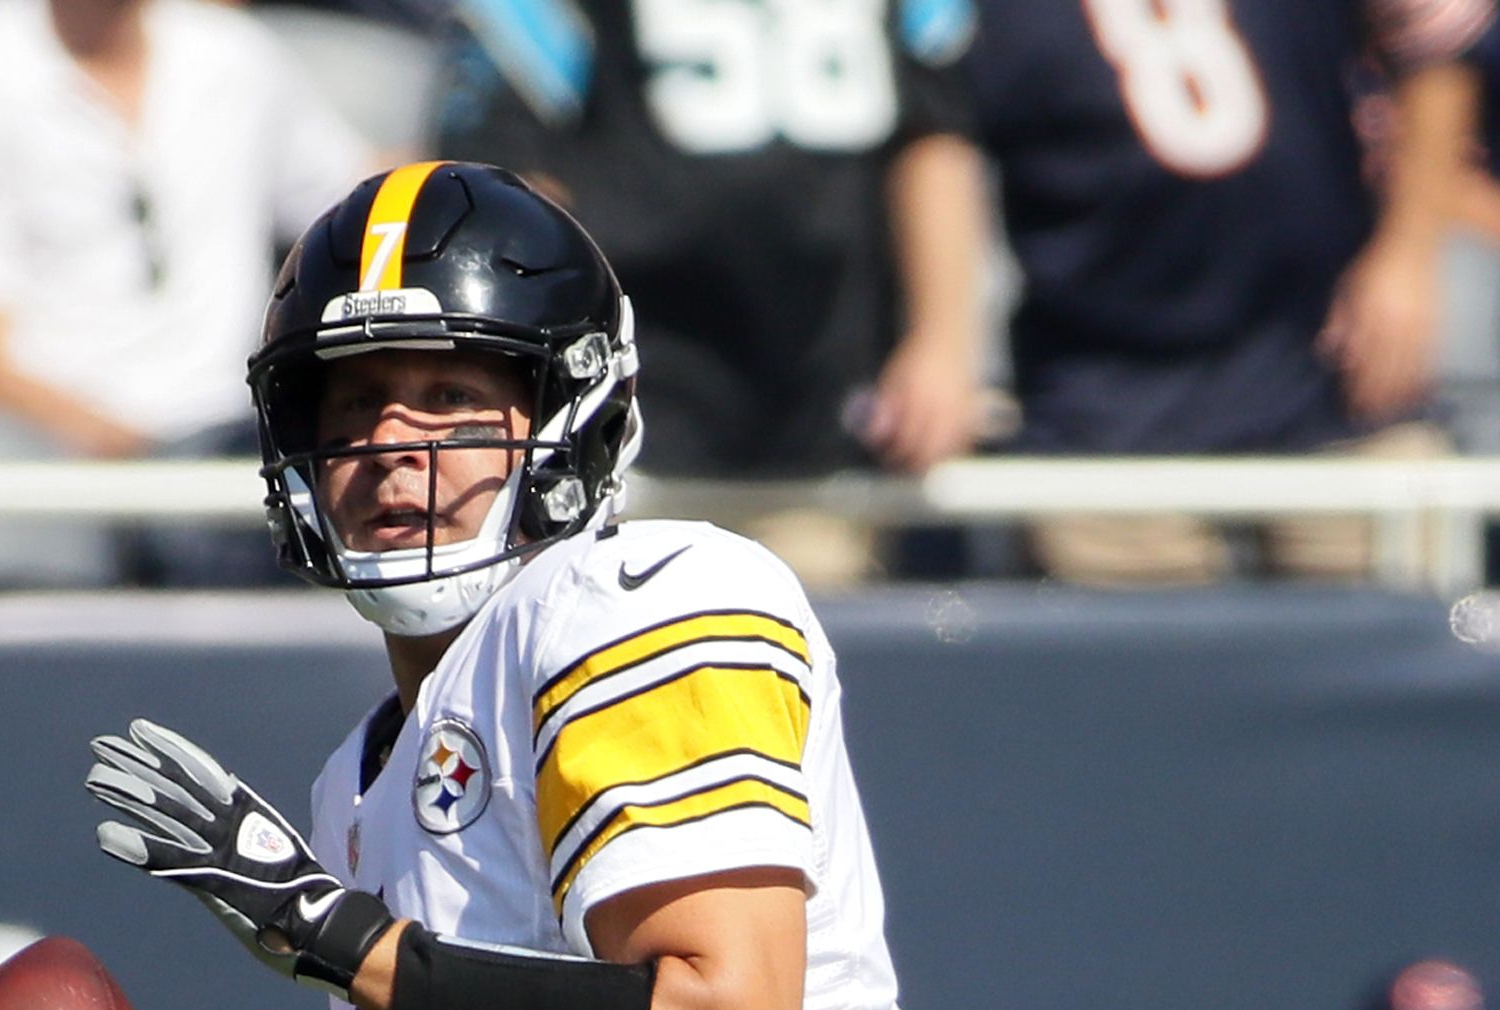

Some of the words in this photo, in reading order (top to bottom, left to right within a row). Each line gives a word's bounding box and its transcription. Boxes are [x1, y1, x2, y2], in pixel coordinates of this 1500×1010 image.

[630, 0, 898, 154] 58
[1080, 0, 1272, 182] 8
[342, 291, 407, 316] Steelers
[360, 221, 408, 293] 7
